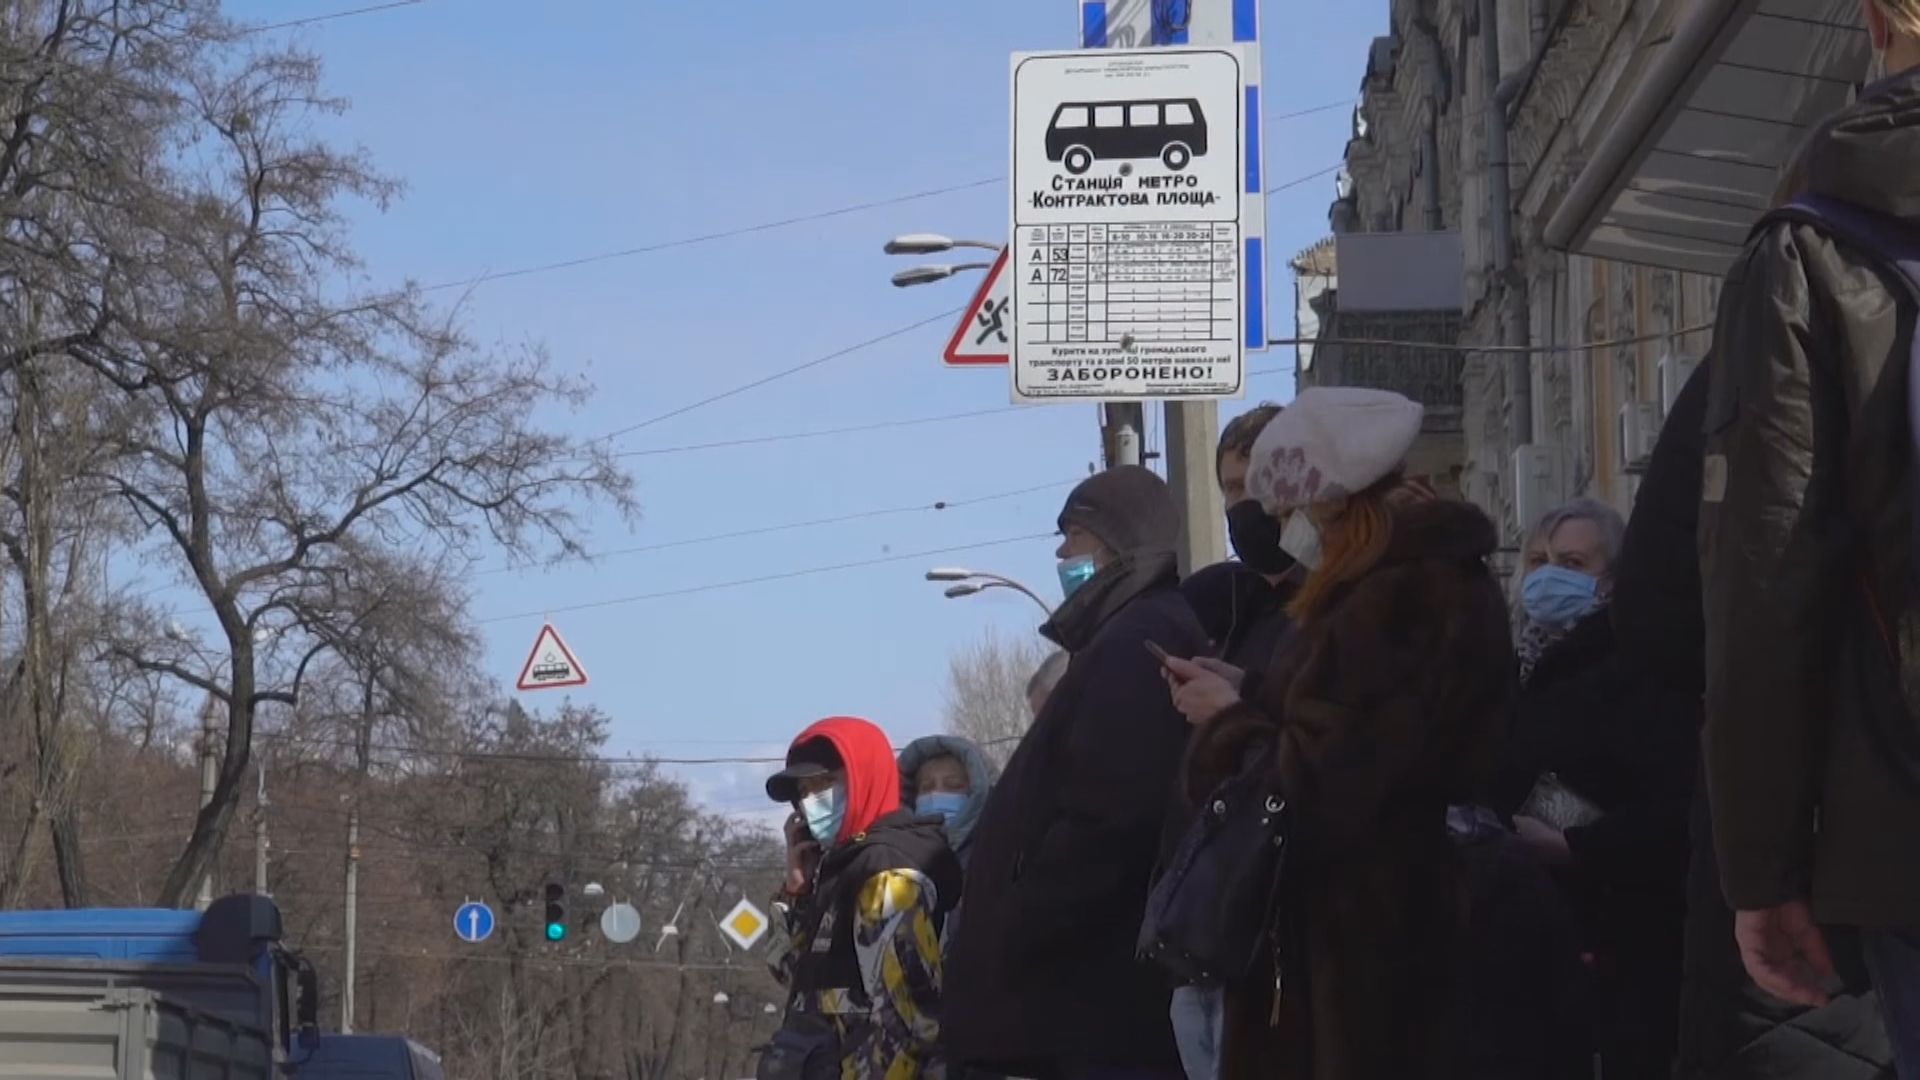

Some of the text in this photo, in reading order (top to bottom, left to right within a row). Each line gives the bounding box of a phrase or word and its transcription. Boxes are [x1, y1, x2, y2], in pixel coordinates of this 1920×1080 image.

[1052, 247, 1069, 261] 53
[1050, 268, 1067, 281] 72
[1127, 356, 1139, 365] 50
[1047, 366, 1212, 381] ЗАБОРОНЕНО!
